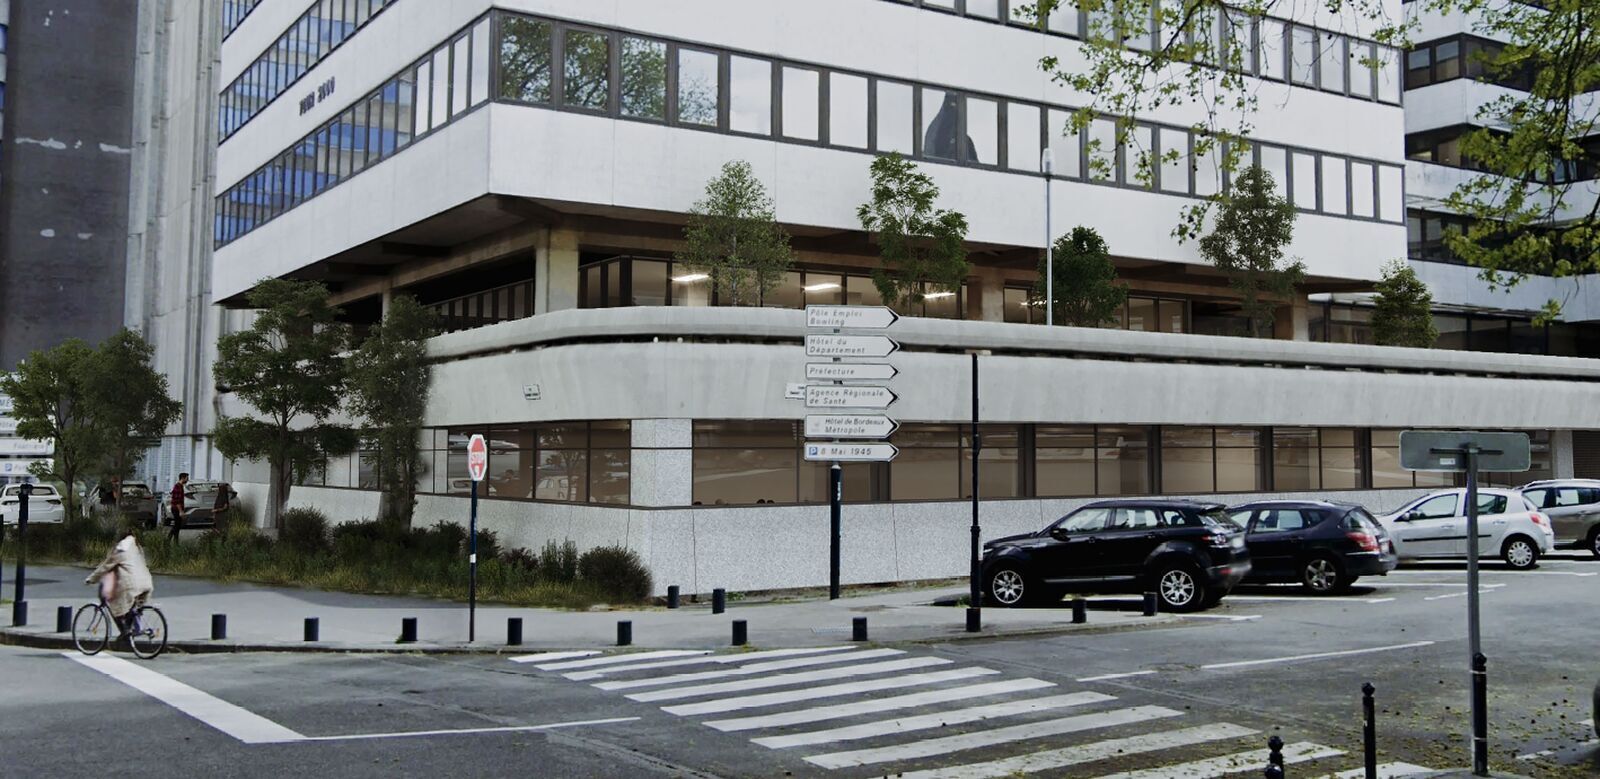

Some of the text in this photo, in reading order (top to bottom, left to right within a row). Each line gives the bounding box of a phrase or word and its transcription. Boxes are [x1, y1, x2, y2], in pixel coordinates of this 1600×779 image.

[810, 317, 845, 327] Bowling
[837, 337, 847, 345] du
[809, 388, 839, 397] Agence
[809, 397, 819, 405] de
[844, 418, 852, 426] de
[853, 418, 885, 426] Bordeaux
[820, 447, 826, 456] 8
[831, 447, 846, 456] Mai
[851, 447, 872, 456] 1945
